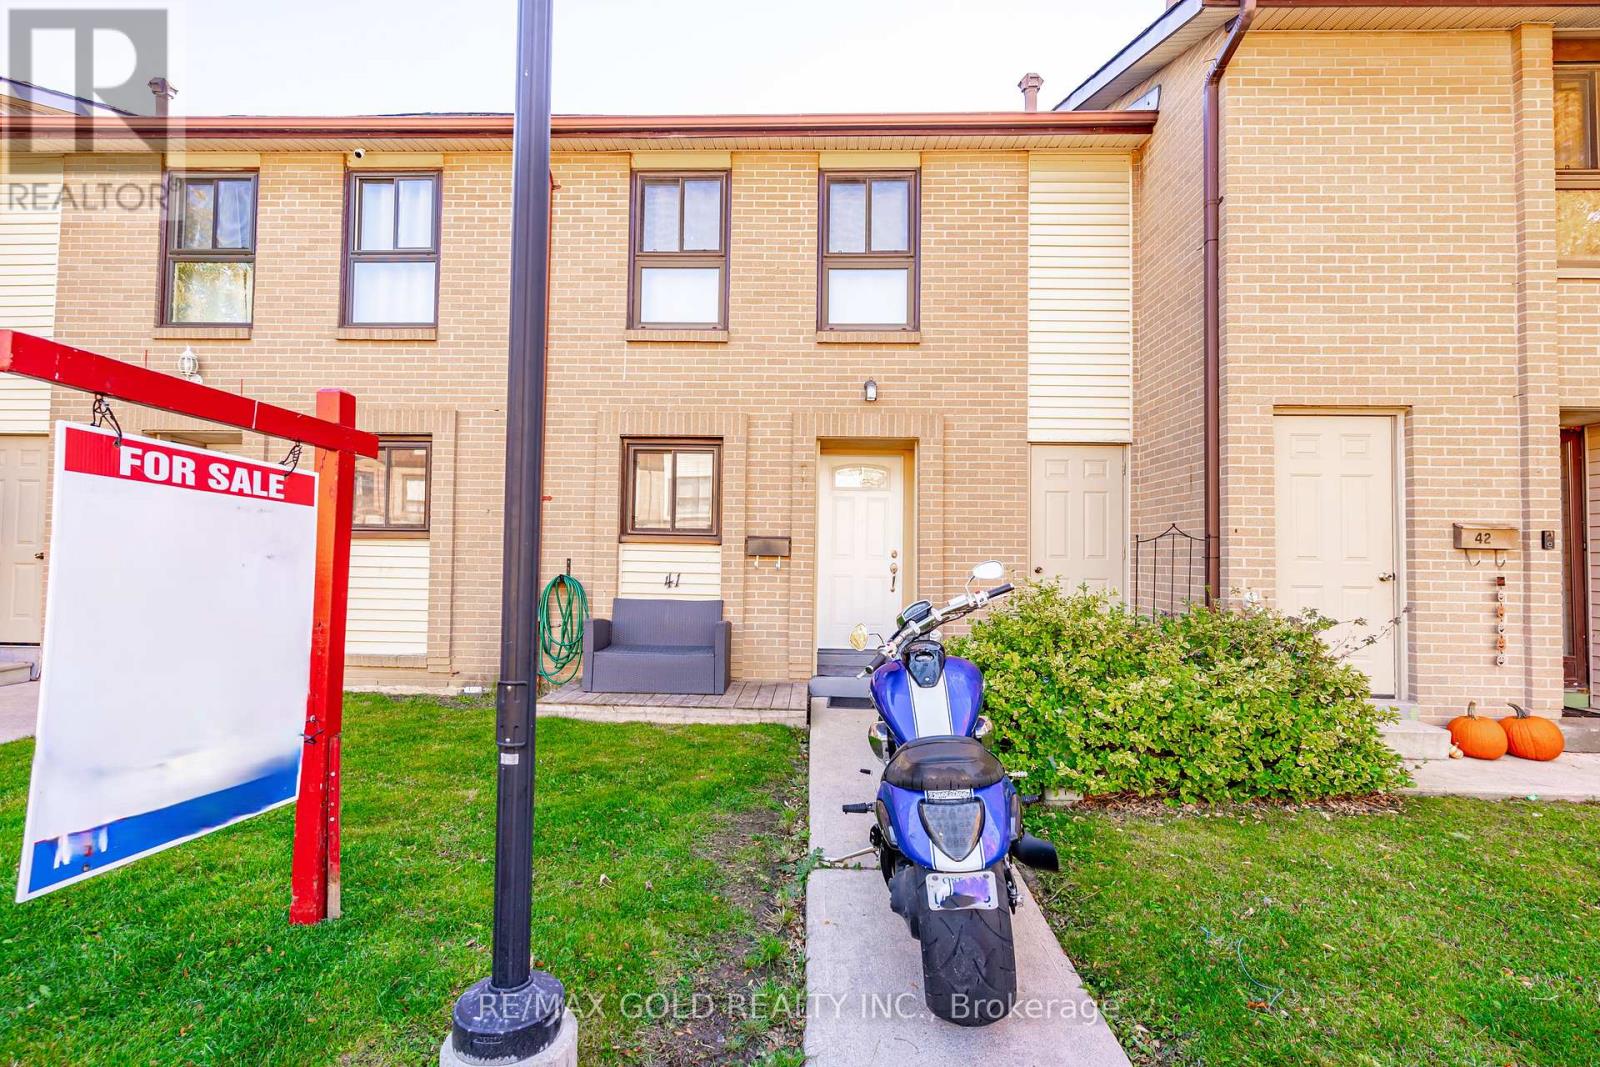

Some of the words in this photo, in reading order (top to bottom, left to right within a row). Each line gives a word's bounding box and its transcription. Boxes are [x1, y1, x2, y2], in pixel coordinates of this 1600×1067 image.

[119, 445, 196, 487] FOR
[207, 462, 286, 499] SALE
[1474, 532, 1491, 544] 42
[664, 572, 681, 588] 41
